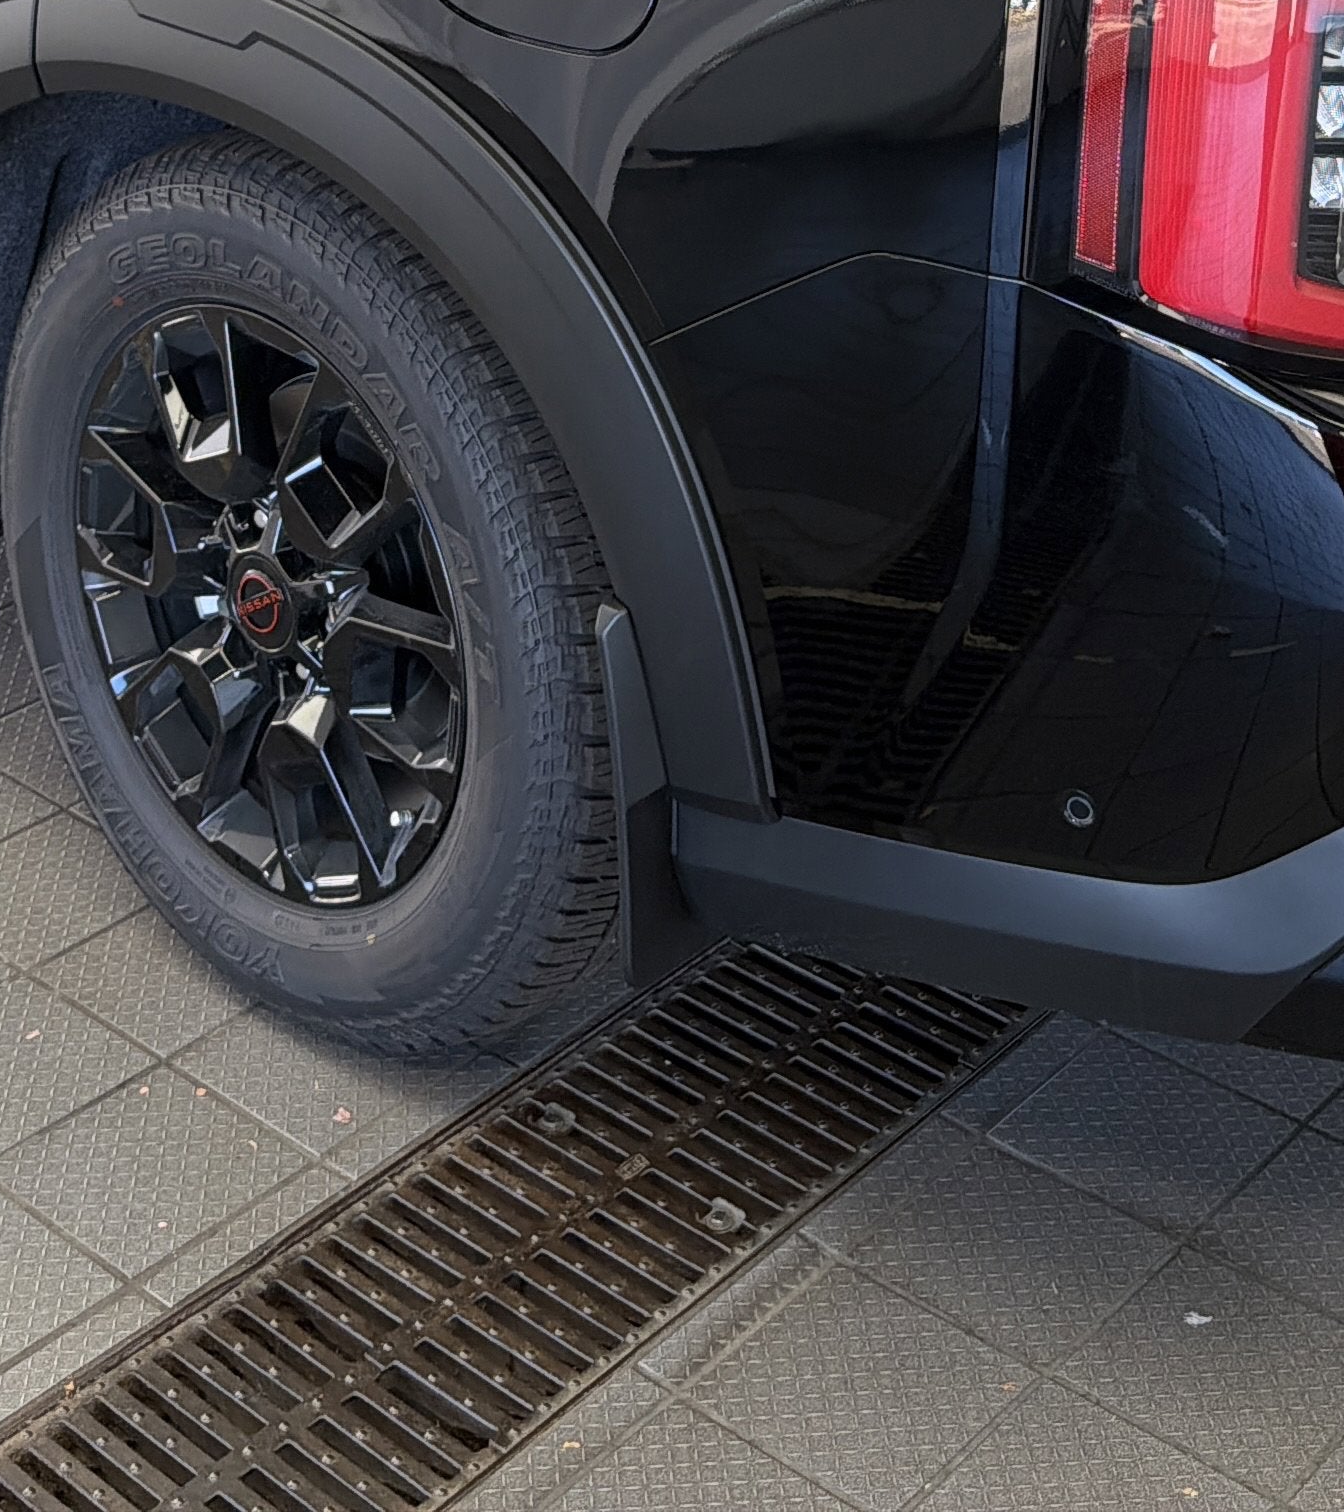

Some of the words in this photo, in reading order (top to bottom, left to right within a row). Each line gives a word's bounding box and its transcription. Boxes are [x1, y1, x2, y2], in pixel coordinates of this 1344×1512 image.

[106, 231, 442, 483] GEOLANDAR
[238, 588, 282, 618] NISSAN
[42, 663, 286, 984] YOKOHAMA
